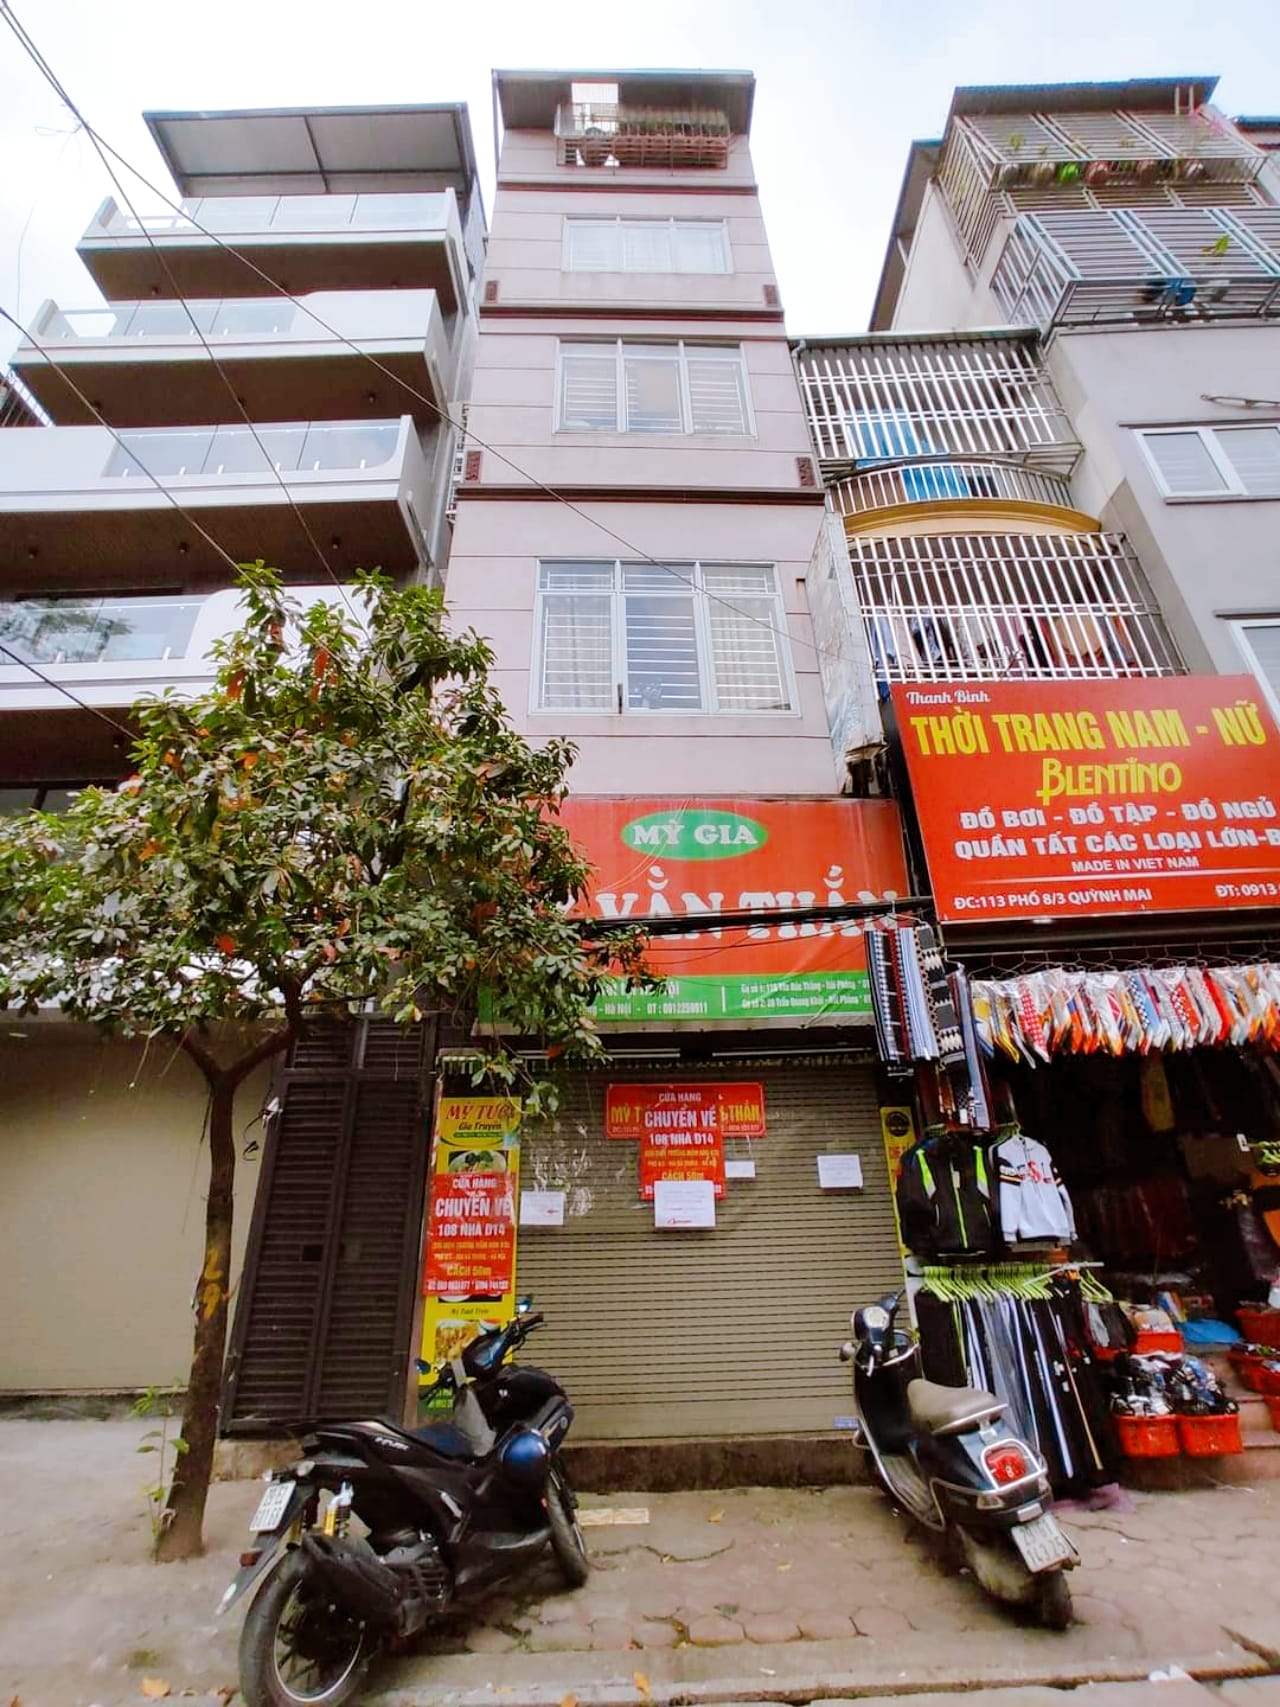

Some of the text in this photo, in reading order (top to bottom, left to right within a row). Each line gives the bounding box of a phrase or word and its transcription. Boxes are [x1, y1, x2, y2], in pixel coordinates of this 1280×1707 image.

[906, 689, 990, 705] Thanh Bình
[910, 706, 989, 756] THỜI
[991, 710, 1106, 753] TRANG
[1106, 709, 1191, 749] NAM
[1211, 700, 1267, 746] NỮ
[1001, 807, 1047, 828] BƠI
[1109, 802, 1157, 826] TẬP
[694, 824, 758, 845] GIA
[1032, 831, 1078, 855] TẤT
[1085, 831, 1138, 853] CÁC
[1143, 831, 1202, 853] LOẠI
[1072, 856, 1199, 872] MADE IN VIET NAM
[1008, 890, 1040, 907] PHỐ
[1043, 893, 1066, 906] 8/3
[1068, 888, 1122, 905] QUỲNH
[1123, 888, 1152, 901] MAI
[1242, 883, 1278, 896] 0913
